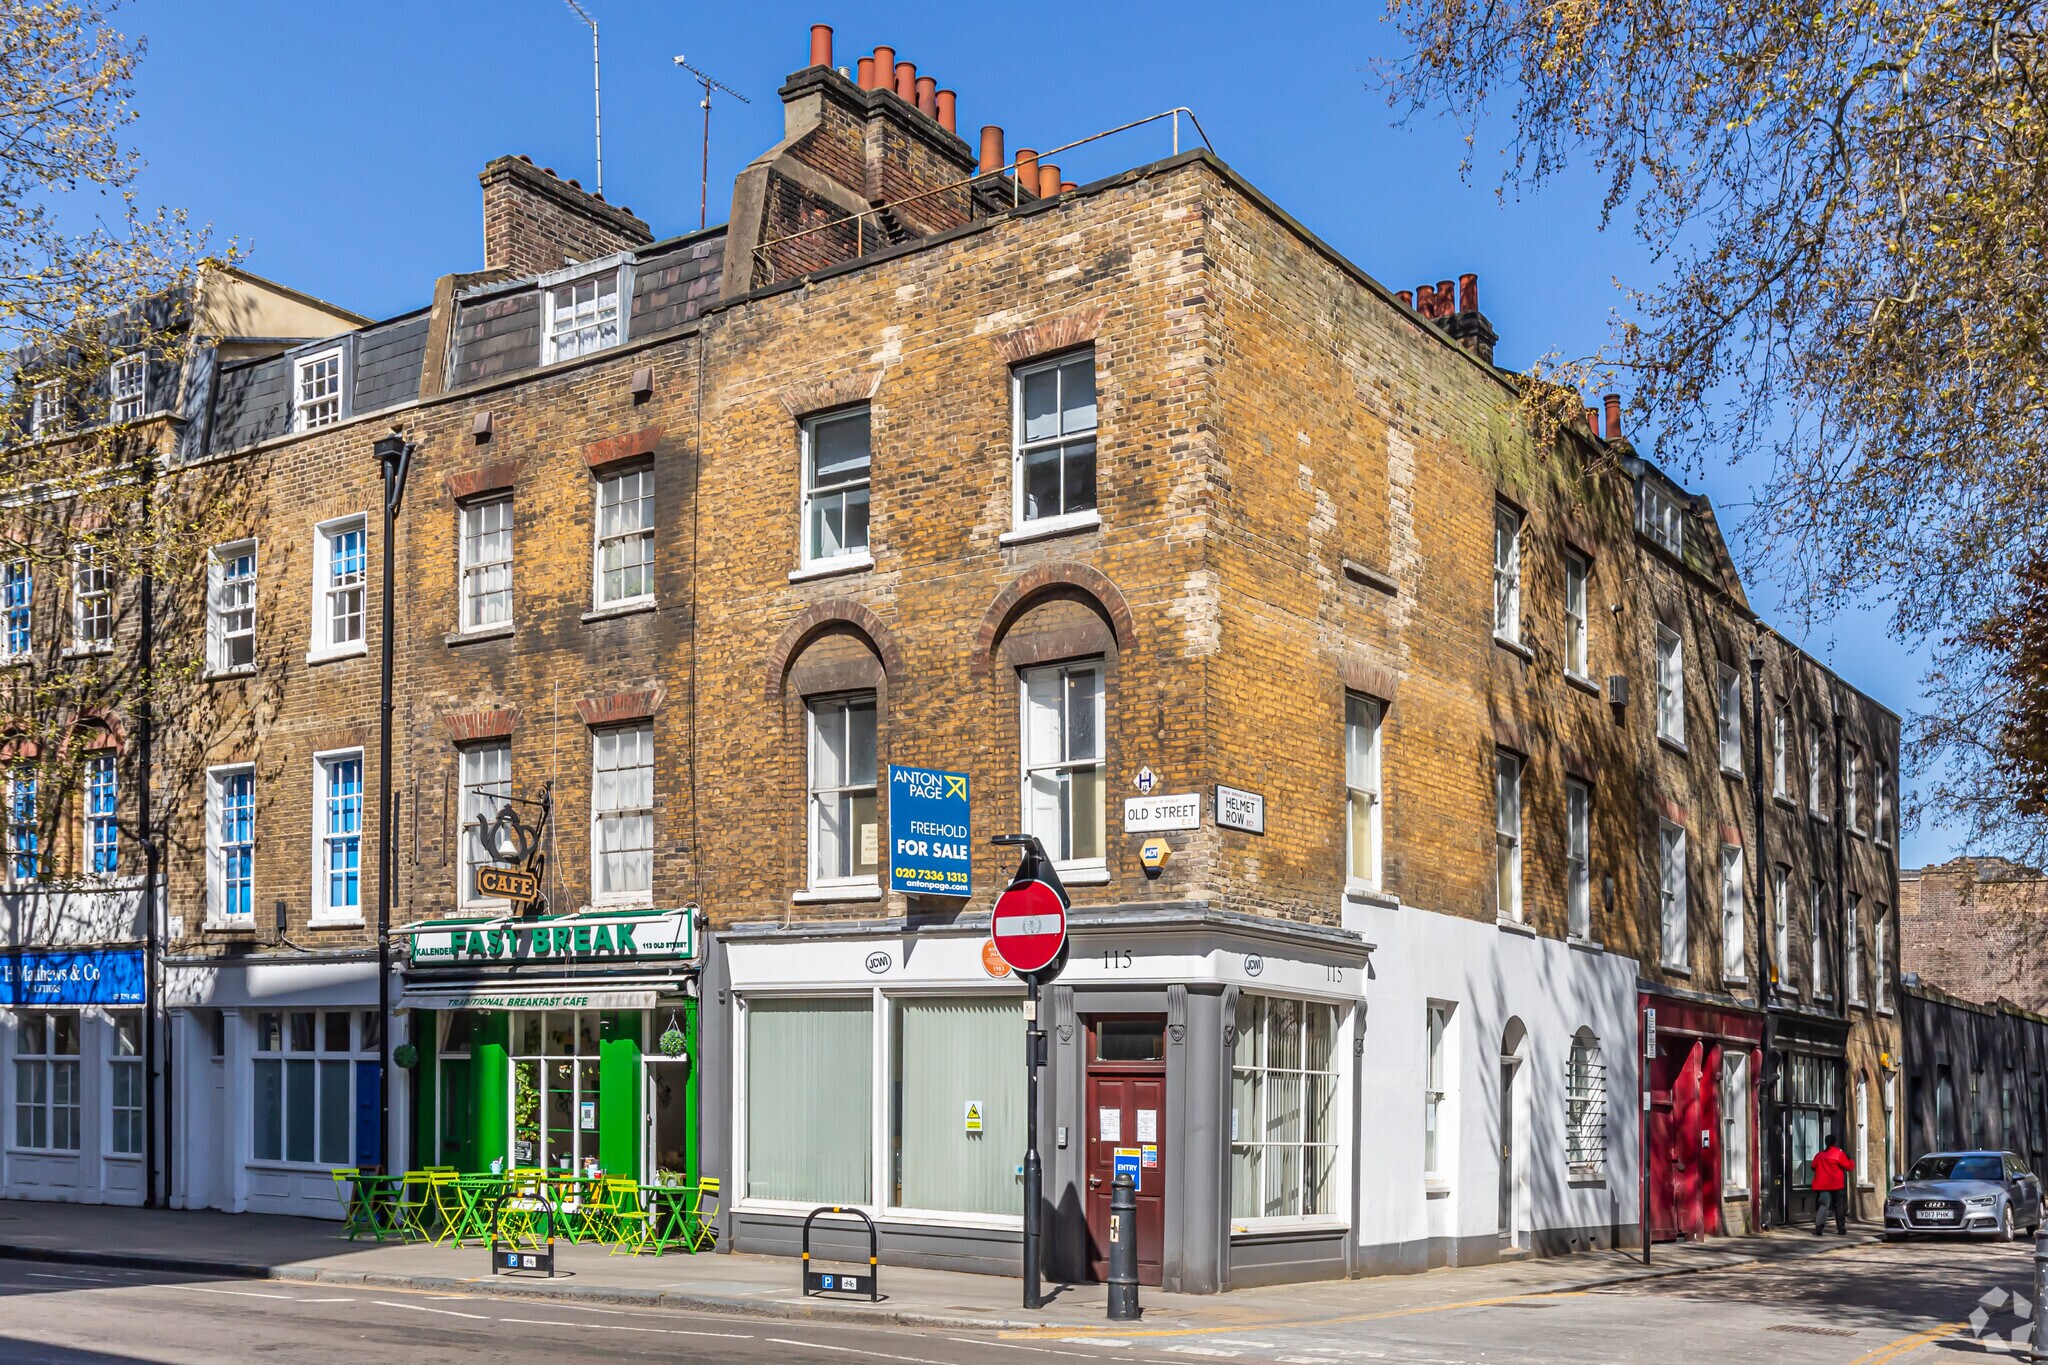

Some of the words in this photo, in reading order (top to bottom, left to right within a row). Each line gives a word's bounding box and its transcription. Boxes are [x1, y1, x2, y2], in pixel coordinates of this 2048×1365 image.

[894, 770, 942, 787] ANTON
[1138, 772, 1152, 789] H
[910, 784, 942, 800] PAGE
[1128, 808, 1149, 820] OLD
[1155, 804, 1196, 819] STREET
[1226, 797, 1255, 814] HELMET
[1226, 810, 1245, 825] ROW
[910, 821, 967, 839] FREEHOLD
[897, 839, 928, 857] FOR
[933, 842, 968, 860] SALE
[1145, 850, 1158, 858] ADT
[895, 867, 916, 879] 020
[918, 869, 944, 881] 7336
[946, 872, 968, 883] 1313
[482, 873, 533, 895] CAFE
[906, 880, 968, 891] antonpage.com
[451, 927, 519, 956] FAST
[532, 922, 638, 955] BREAK
[1102, 949, 1132, 969] 115
[70, 964, 80, 981] &
[84, 964, 100, 981] Co
[1327, 964, 1343, 983] 115
[448, 999, 504, 1007] TRADITIONAL
[507, 997, 560, 1007] BREAKFAST
[562, 997, 588, 1006] CAFE
[825, 1277, 831, 1287] P
